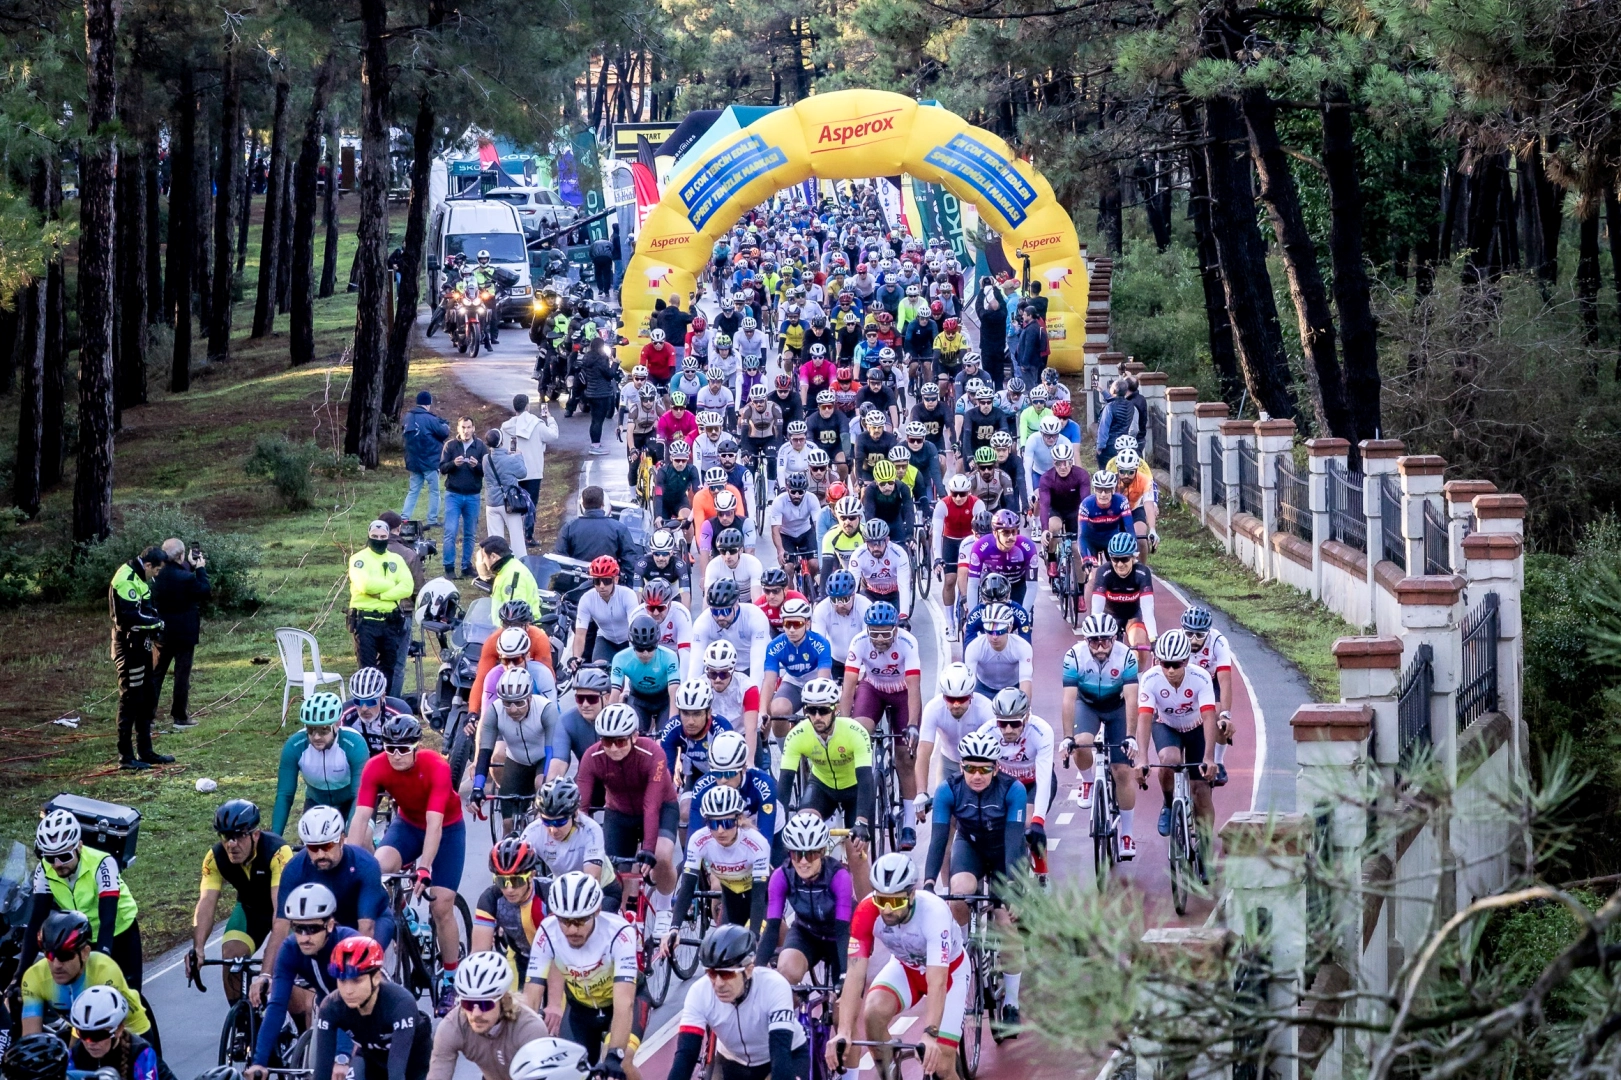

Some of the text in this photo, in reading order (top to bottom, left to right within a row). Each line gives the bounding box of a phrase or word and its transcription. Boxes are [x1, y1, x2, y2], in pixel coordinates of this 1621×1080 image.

[818, 116, 894, 145] Asperox
[650, 236, 690, 248] Asperox
[1022, 235, 1062, 249] Asperox
[660, 718, 681, 742] KARYA
[710, 862, 746, 873] Asperox
[317, 1018, 330, 1031] AS
[393, 1016, 414, 1031] PAS
[540, 1051, 569, 1065] MET
